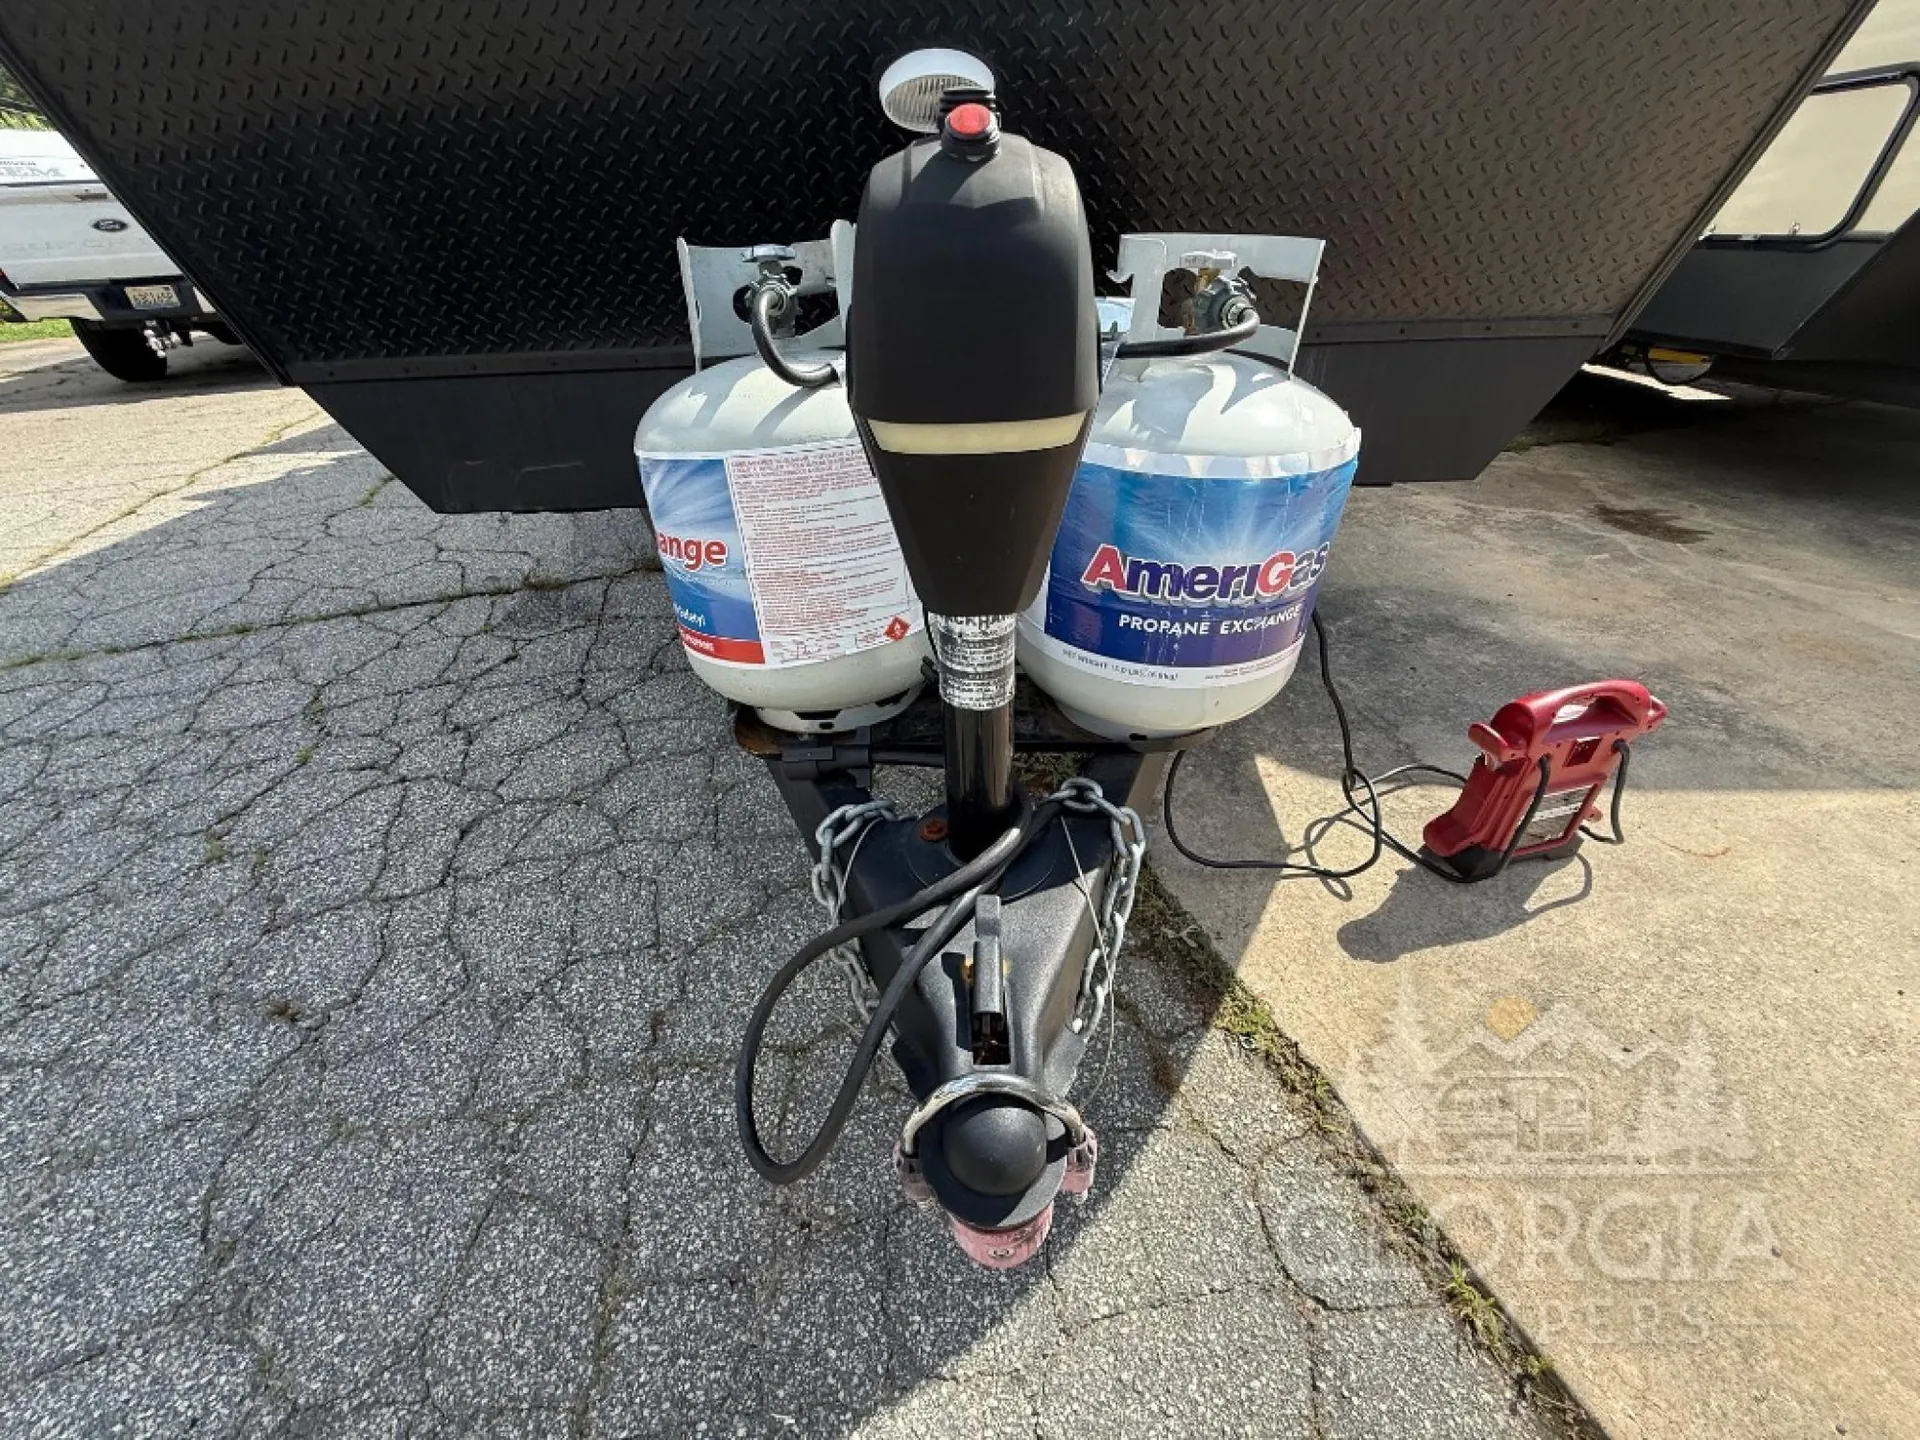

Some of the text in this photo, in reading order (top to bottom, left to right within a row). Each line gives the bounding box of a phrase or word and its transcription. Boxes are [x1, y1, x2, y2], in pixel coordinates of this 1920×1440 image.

[1080, 543, 1330, 604] AmeriGas
[1119, 604, 1303, 636] PROPANE EXCHANGE
